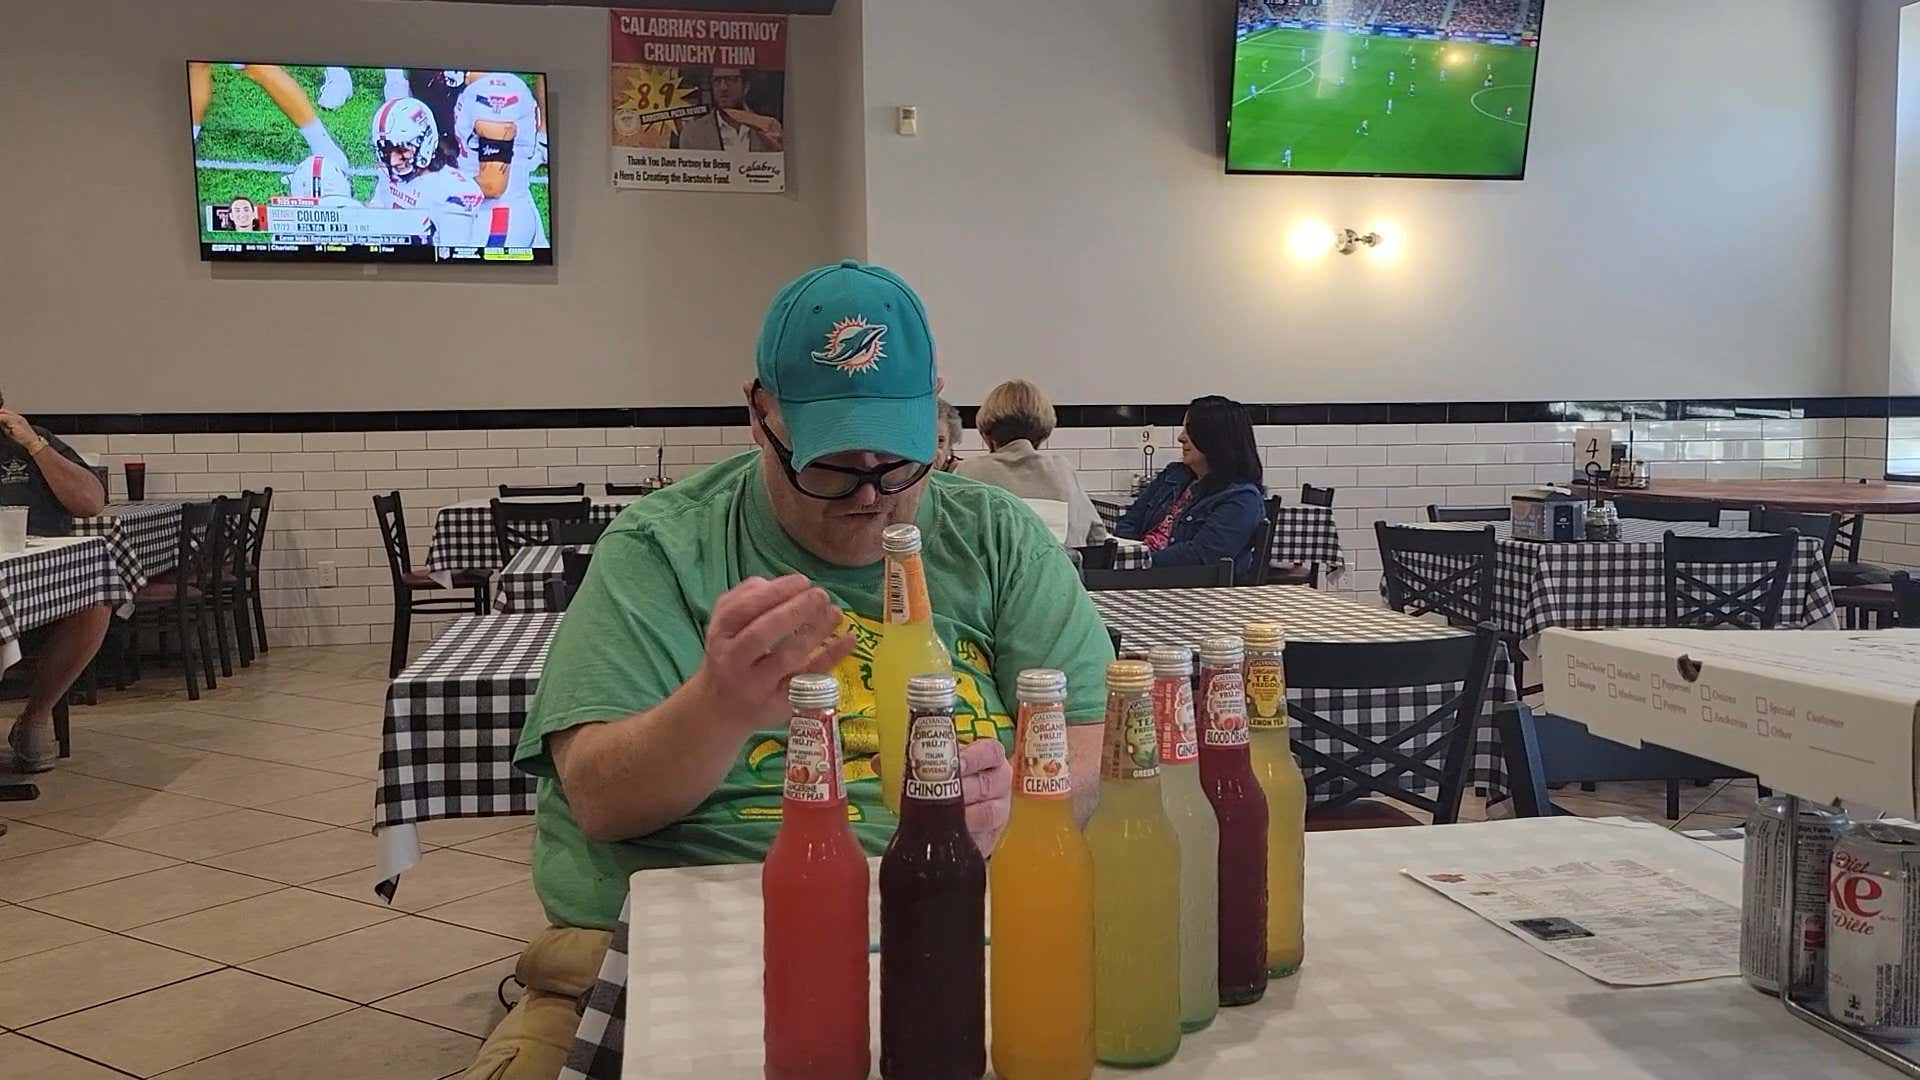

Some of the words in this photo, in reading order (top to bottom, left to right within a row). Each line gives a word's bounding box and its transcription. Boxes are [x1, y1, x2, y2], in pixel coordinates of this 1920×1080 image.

[621, 16, 706, 40] CALABRIA'S
[710, 21, 779, 41] PORTNOY
[644, 43, 716, 63] CRUNCHY
[719, 46, 756, 65] THIN
[628, 155, 647, 166] Thank
[661, 157, 676, 167] Dave
[678, 158, 701, 170] Portnoy
[702, 160, 712, 169] for
[713, 159, 731, 171] Being
[619, 170, 634, 181] Hero
[642, 172, 669, 184] Creating
[671, 173, 681, 183] the
[683, 174, 712, 185] Barstools
[297, 210, 339, 222] COLOMBI
[1142, 430, 1150, 442] 9
[1585, 438, 1599, 460] 4
[915, 730, 954, 740] ORGANIC
[1206, 730, 1230, 744] BLOOD
[807, 791, 825, 800] PEAR
[908, 781, 959, 798] CHINOTTO
[1835, 851, 1871, 874] Diet
[1828, 871, 1883, 918] ke
